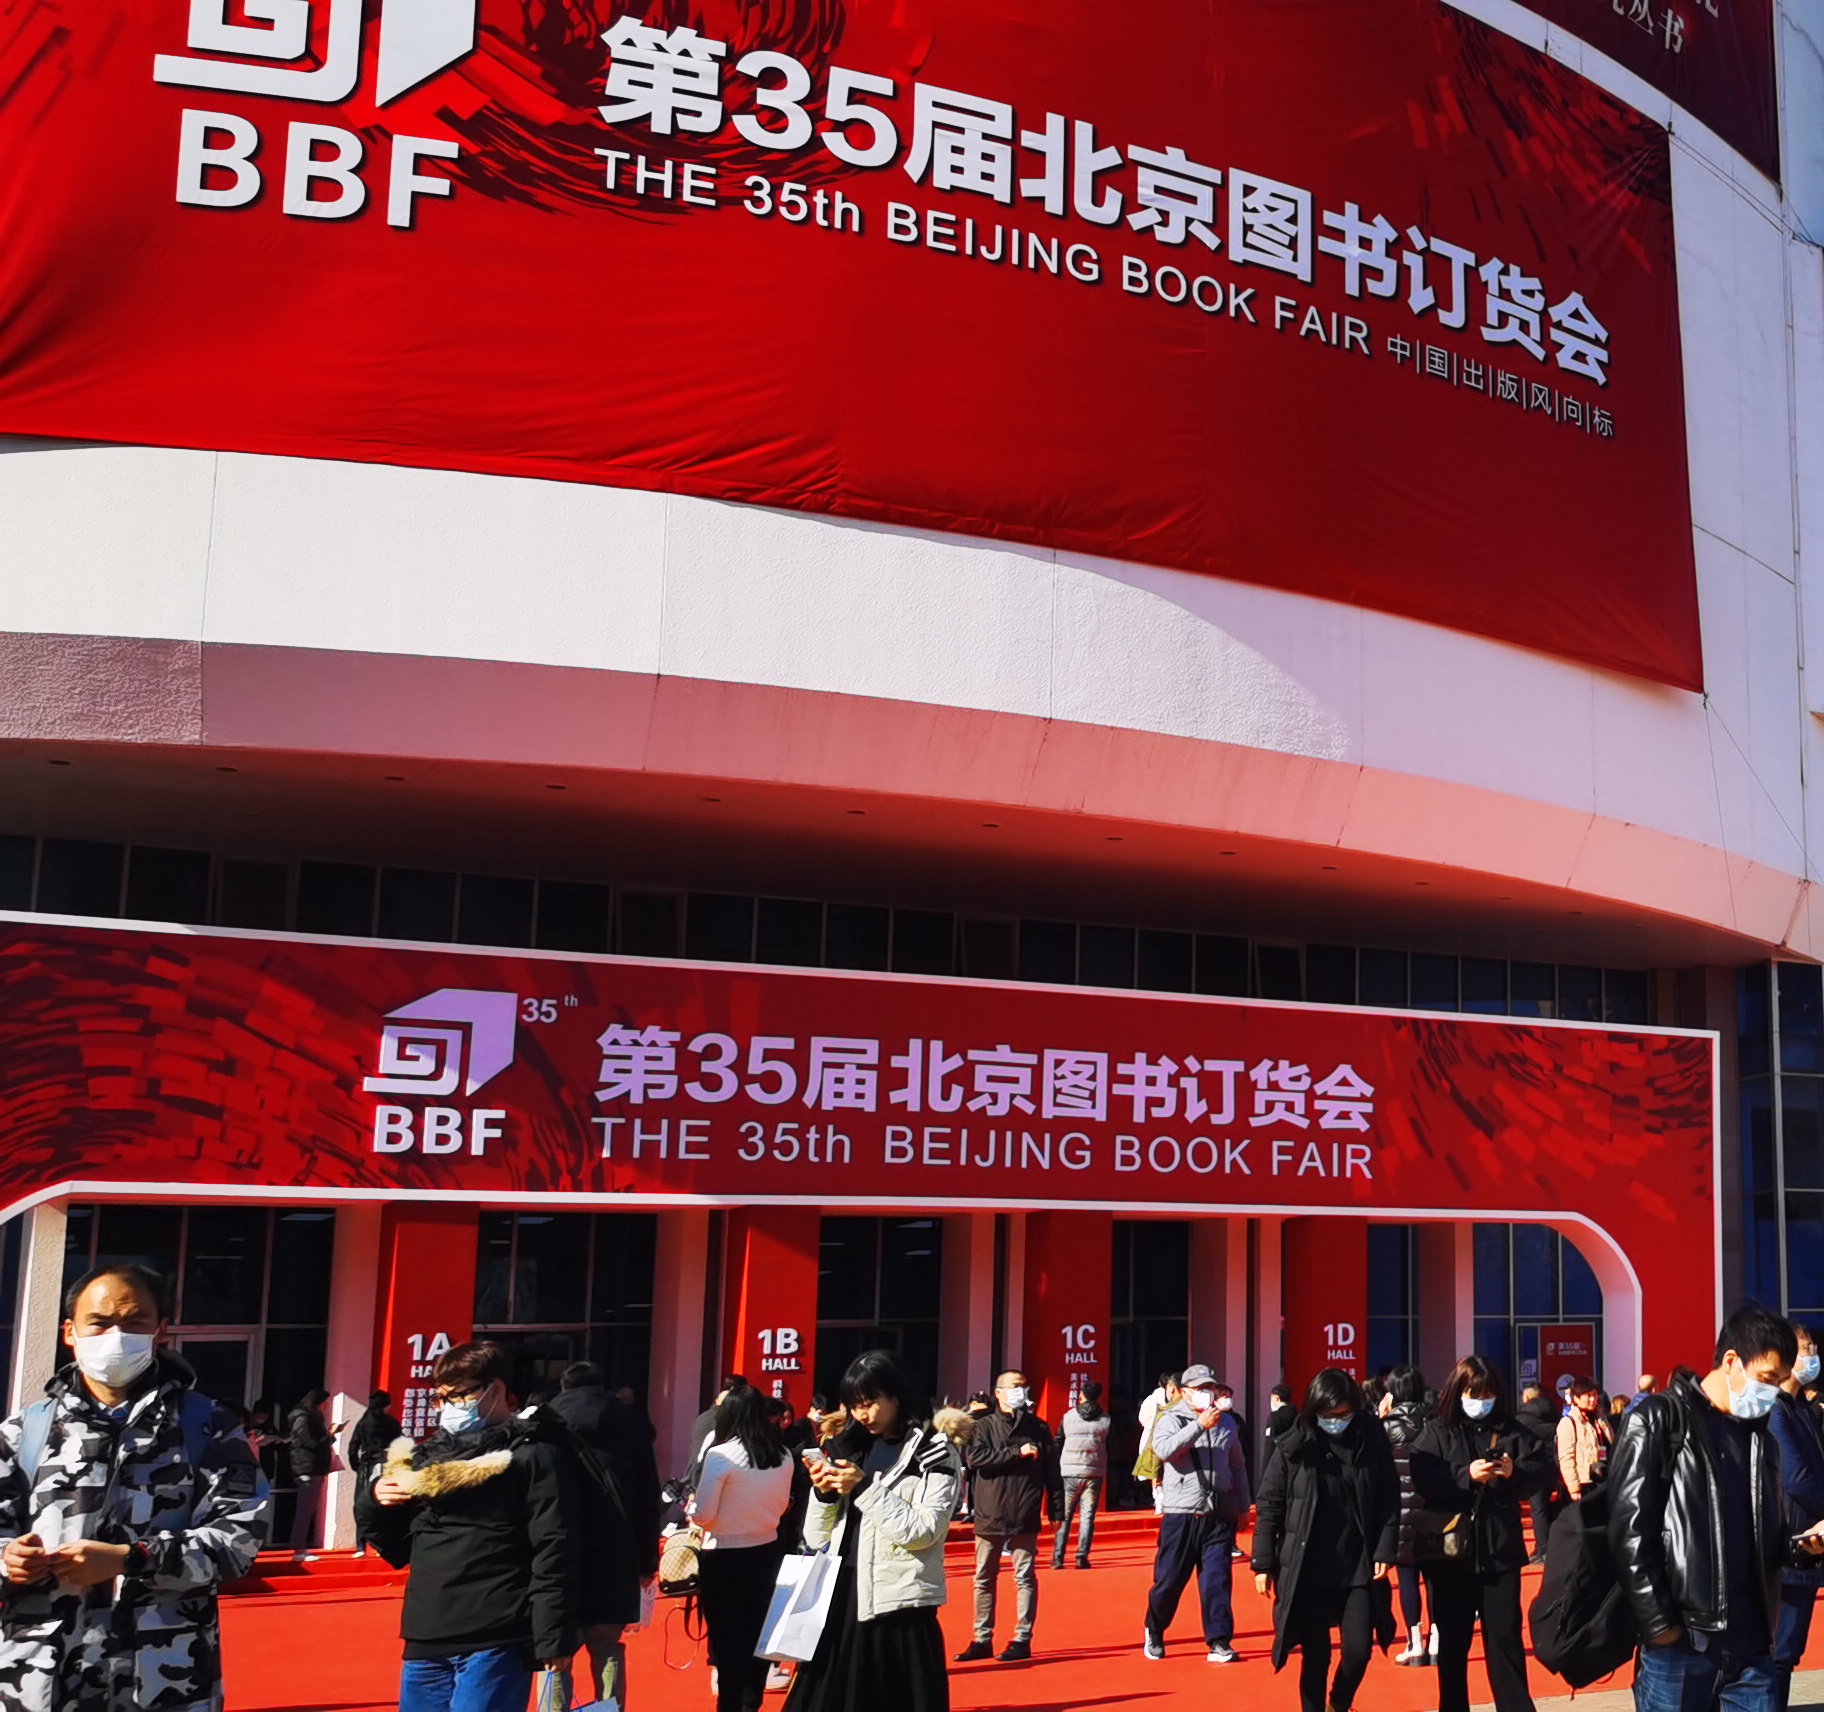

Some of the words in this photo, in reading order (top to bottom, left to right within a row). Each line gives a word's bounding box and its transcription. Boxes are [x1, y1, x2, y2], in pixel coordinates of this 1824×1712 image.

[174, 107, 461, 229] BBF
[598, 14, 1610, 385] 第35届北京图书订货会
[593, 146, 720, 208] THE
[743, 174, 862, 234] 35th
[886, 200, 1102, 283] BEIJING
[1121, 254, 1258, 325] BOOK
[1274, 297, 1371, 354] FAIR
[594, 1023, 1374, 1132] 第35届北京图书订货会
[373, 1105, 506, 1156] BBF
[591, 1116, 711, 1160] THE
[738, 1121, 851, 1164] 35th
[884, 1125, 1092, 1171] BEIJING
[1114, 1134, 1252, 1176] BOOK
[1272, 1140, 1373, 1180] FAIR
[407, 1332, 451, 1361] 1A
[758, 1327, 799, 1355] 1B
[1061, 1324, 1096, 1350] 1C
[1323, 1322, 1355, 1346] 1D
[761, 1357, 800, 1371] HALL
[1065, 1352, 1098, 1364] HALL
[1327, 1349, 1356, 1360] HALL
[410, 1365, 434, 1378] HA
